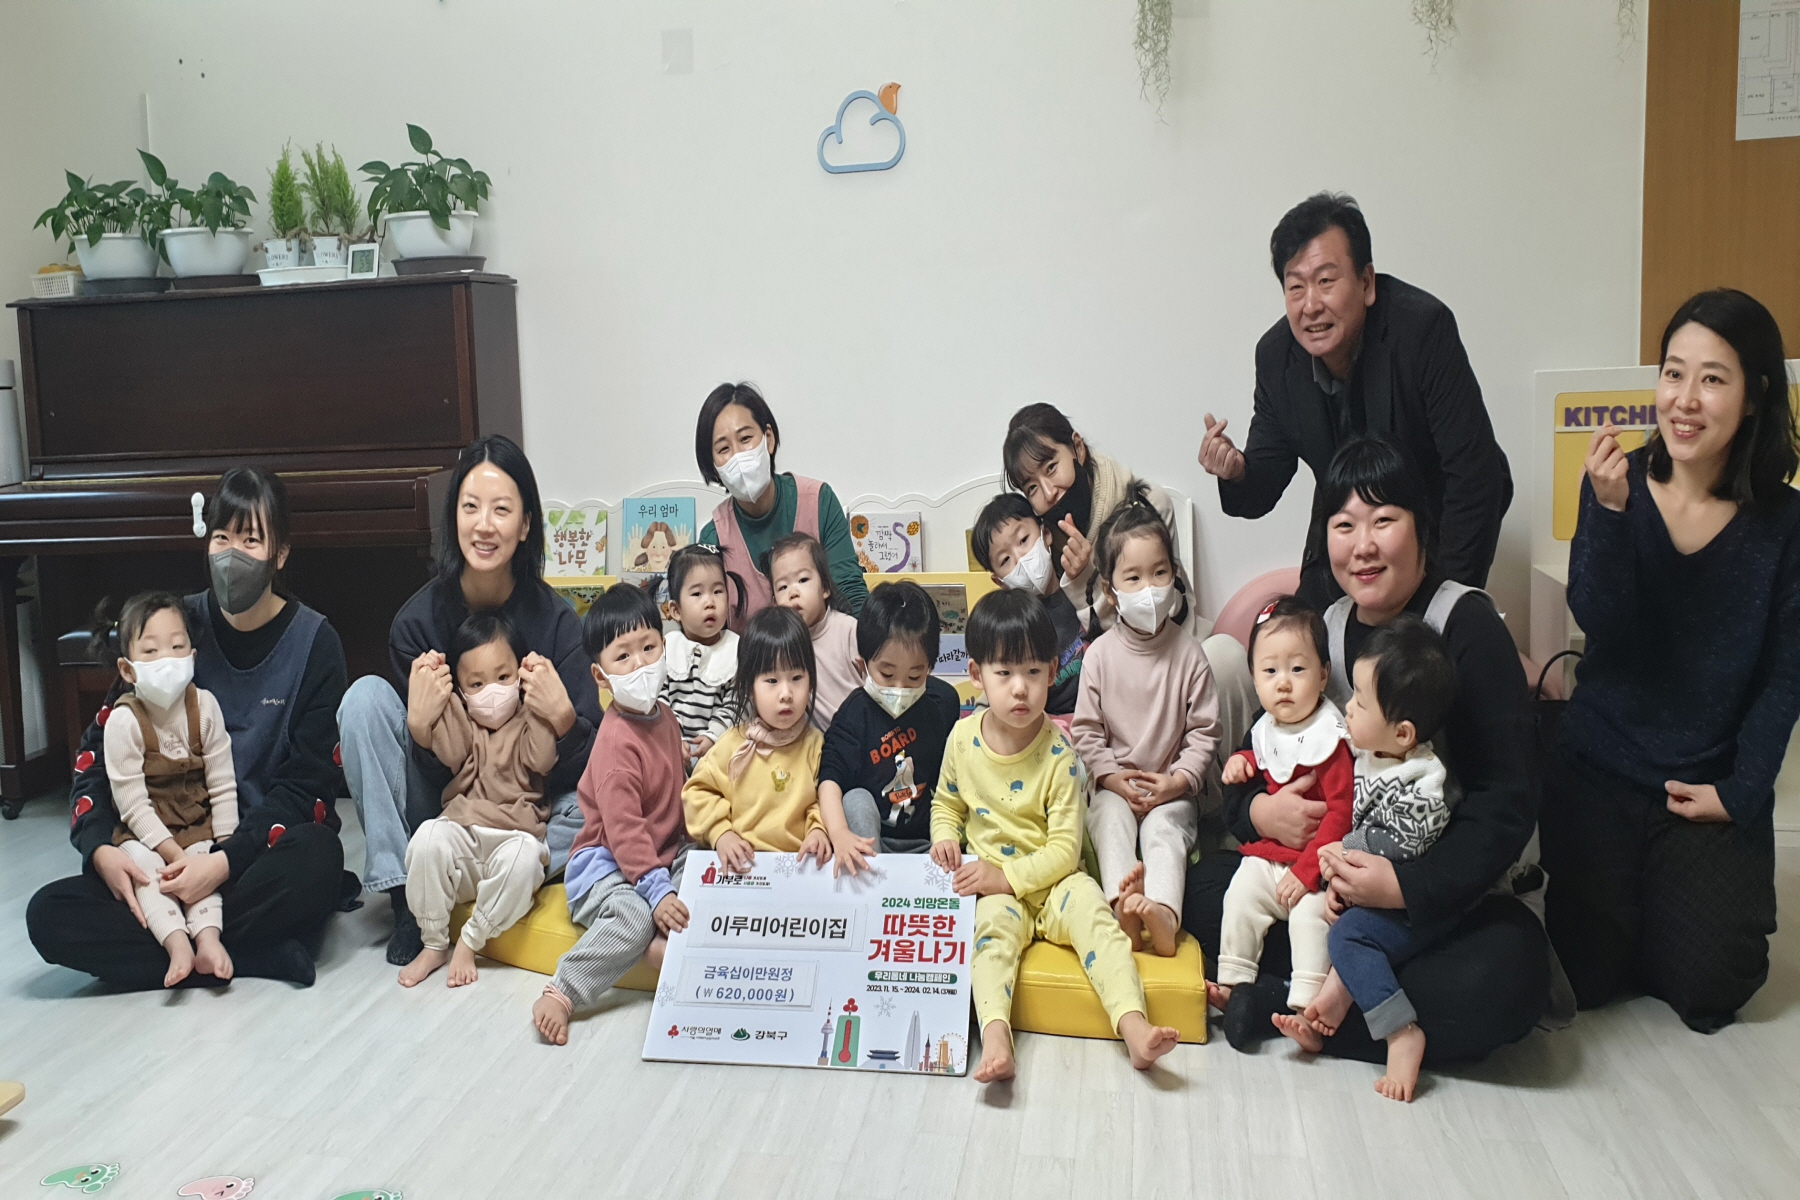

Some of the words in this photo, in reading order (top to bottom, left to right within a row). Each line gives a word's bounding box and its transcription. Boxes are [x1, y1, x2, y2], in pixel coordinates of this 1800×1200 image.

[638, 504, 657, 518] 우리
[659, 503, 679, 518] 엄마
[553, 526, 592, 549] 행복한
[875, 530, 892, 541] 깜짝
[868, 539, 888, 552] 놀라서
[557, 549, 588, 568] 나무
[869, 727, 917, 765] BOARD
[881, 897, 911, 908] 2024
[913, 897, 960, 910] 희망온돌
[711, 915, 847, 939] 이루미어린이집
[883, 914, 956, 938] 따뜻한
[868, 939, 966, 965] 겨울나기
[704, 965, 793, 982] 금육십이만원정
[874, 971, 907, 981] 우리동네
[909, 972, 951, 983] 나눔캠페인
[681, 1026, 722, 1036] 사랑의열매
[755, 1030, 788, 1041] 강북구
